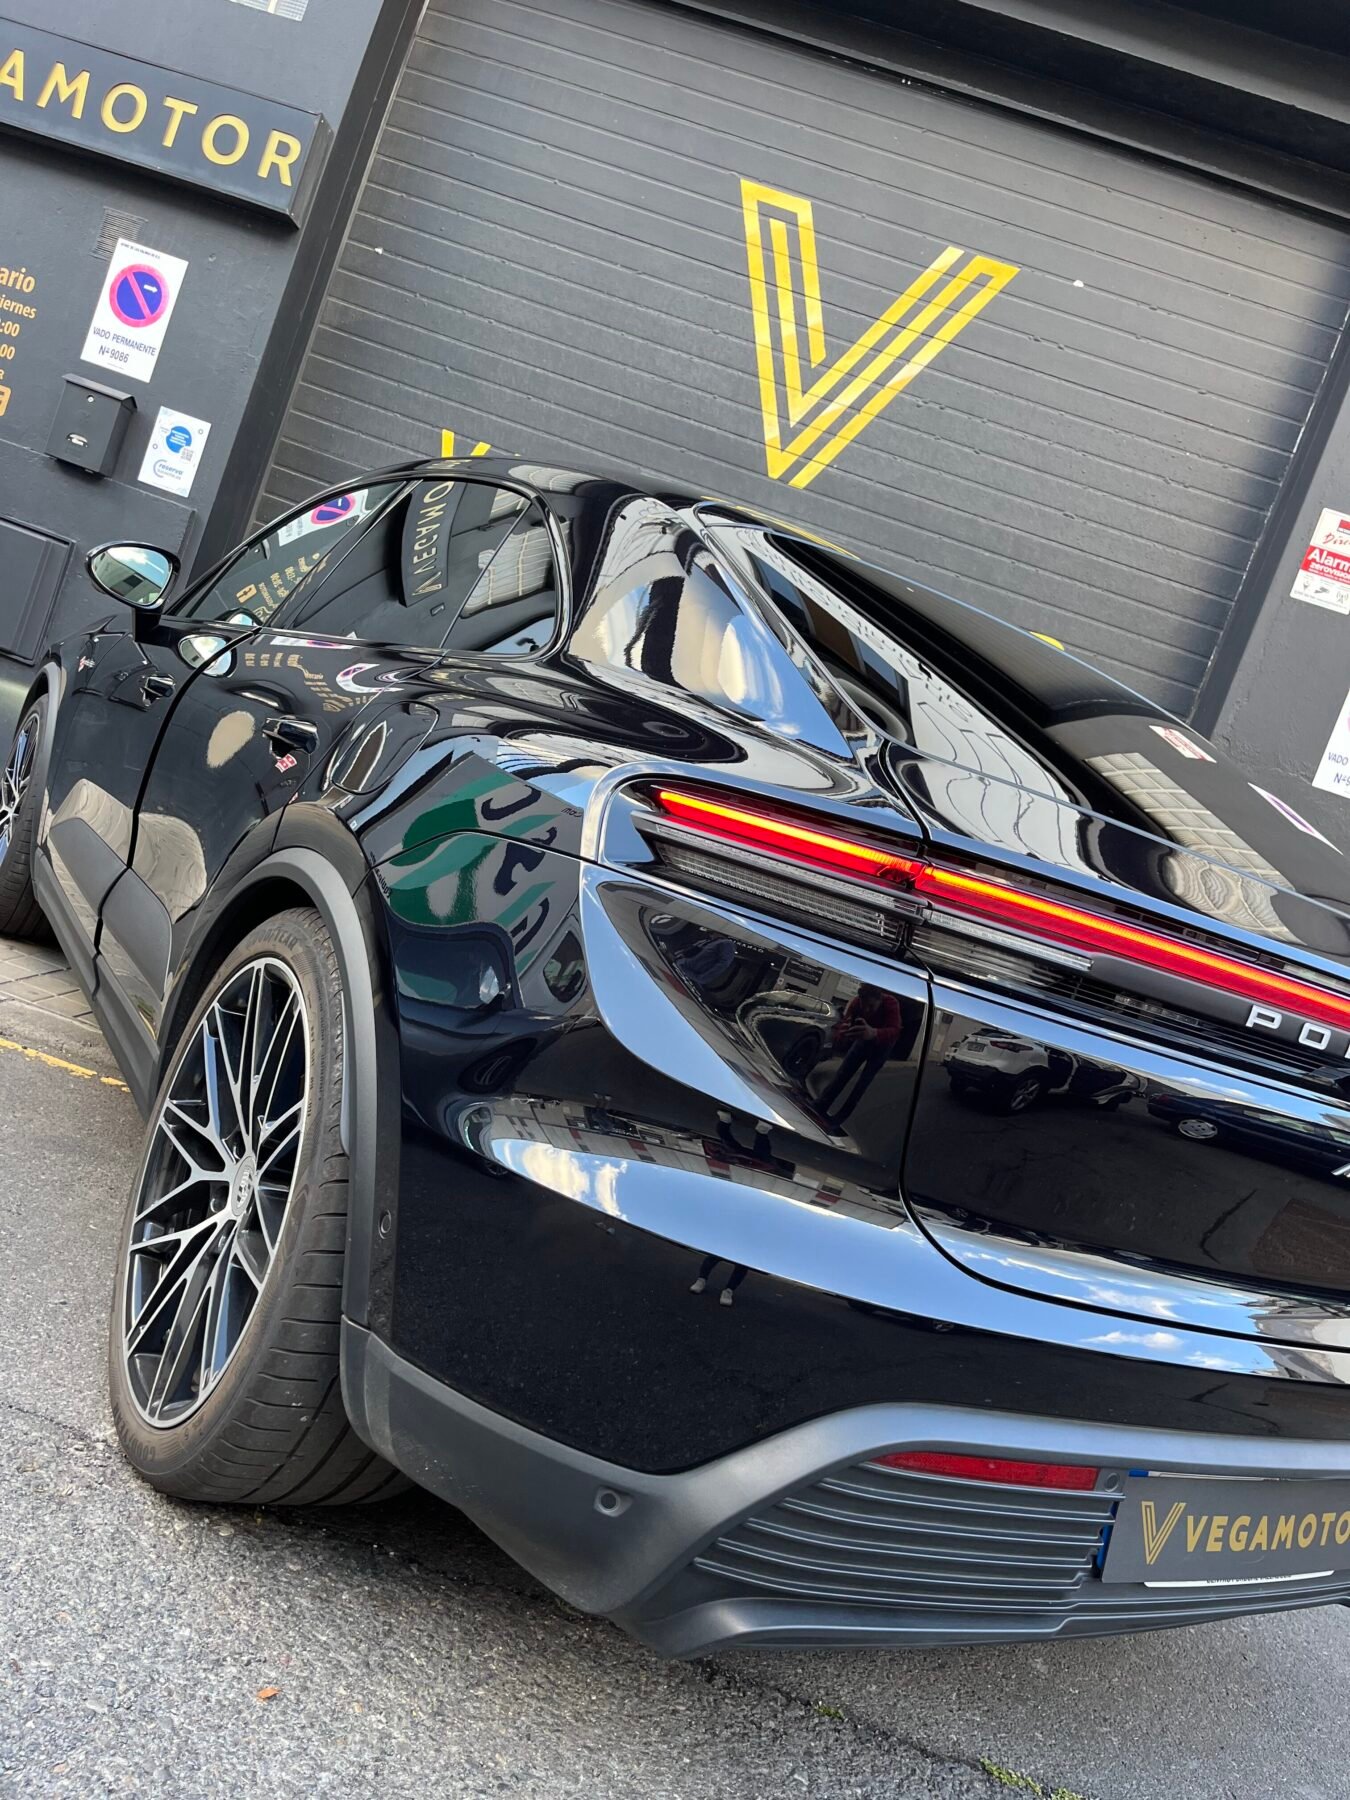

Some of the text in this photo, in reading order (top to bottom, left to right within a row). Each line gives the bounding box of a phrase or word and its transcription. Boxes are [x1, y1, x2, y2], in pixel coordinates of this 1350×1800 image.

[0, 48, 302, 187] AMOTOR
[0, 294, 37, 319] iernes
[93, 327, 157, 356] VADO PERMANENTE
[1328, 752, 1349, 766] VADO
[1245, 1004, 1350, 1059] PO
[1186, 1510, 1350, 1553] VEGAMOTO
